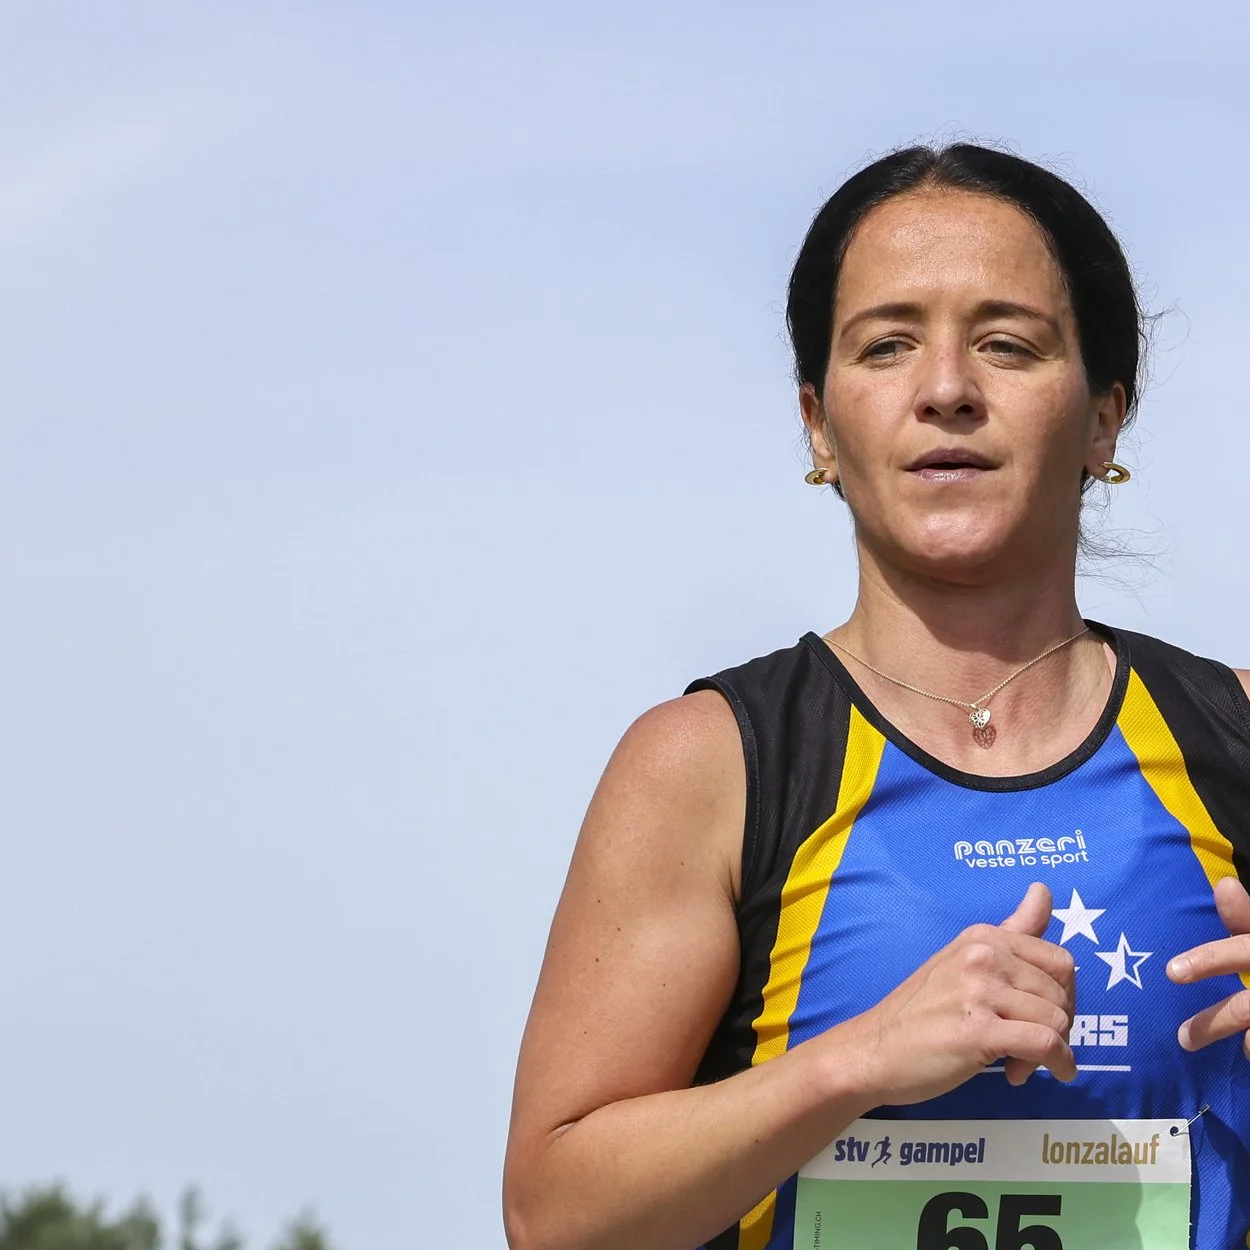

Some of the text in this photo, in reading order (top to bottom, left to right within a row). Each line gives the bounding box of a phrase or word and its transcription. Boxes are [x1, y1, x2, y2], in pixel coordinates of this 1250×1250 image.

[954, 829, 1086, 860] panzeri
[966, 850, 1089, 868] veste lo sport
[835, 1137, 985, 1166] stv gampel
[1042, 1133, 1160, 1166] lonzalauf
